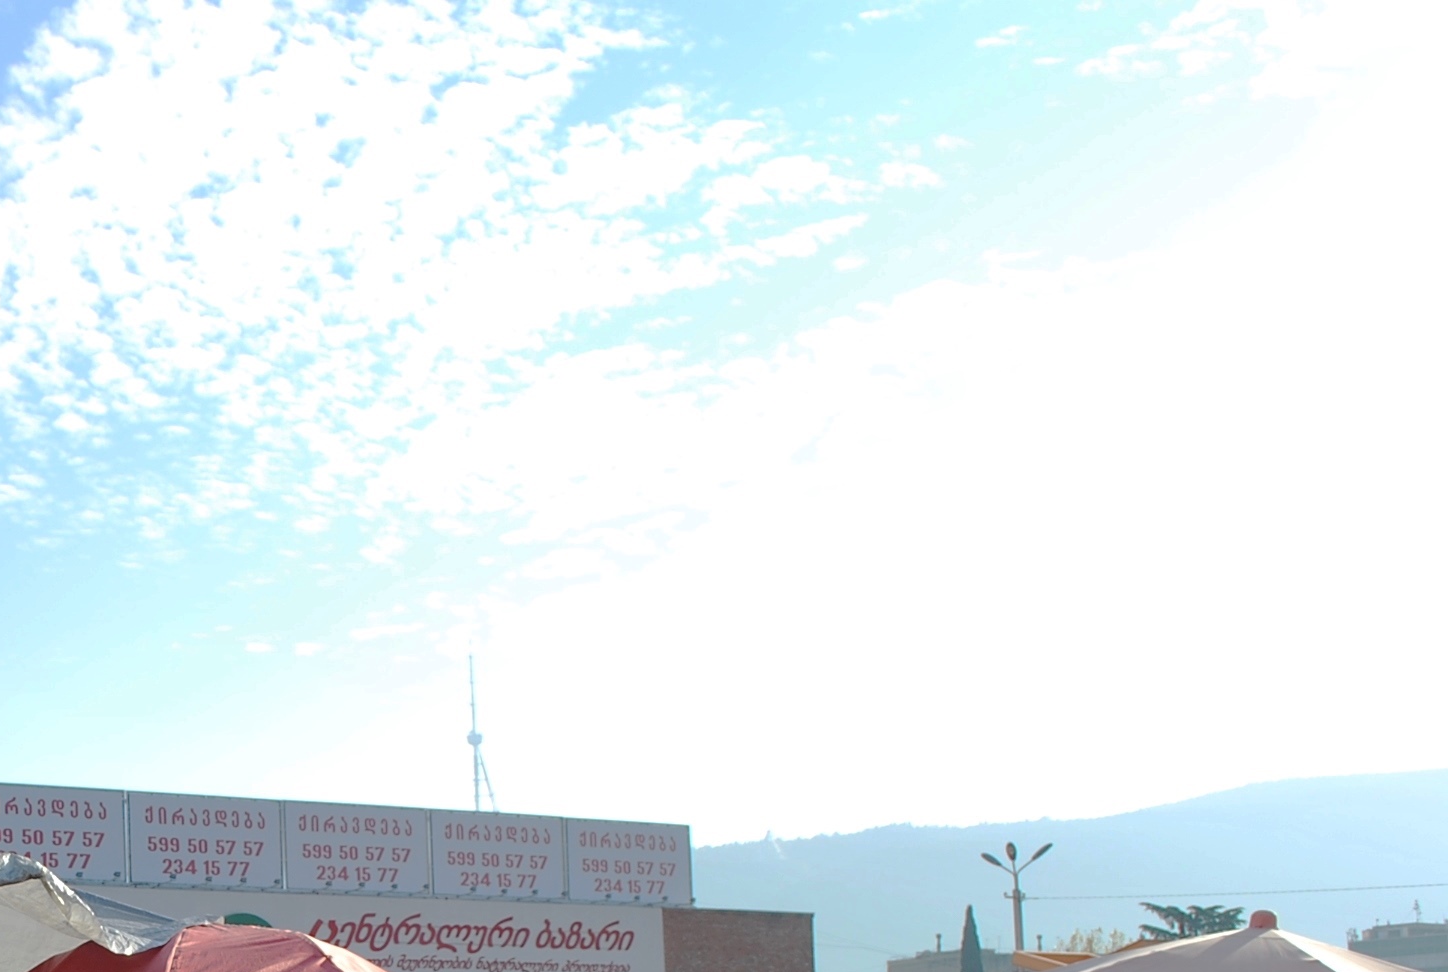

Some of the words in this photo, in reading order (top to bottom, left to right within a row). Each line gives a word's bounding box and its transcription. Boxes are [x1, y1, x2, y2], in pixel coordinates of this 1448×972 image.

[144, 805, 266, 830] ქირავდება
[298, 813, 413, 837] ქირავდება
[21, 829, 44, 845] 50
[52, 830, 75, 847] 57
[82, 831, 105, 848] 57
[444, 823, 551, 846] ქირავდება
[579, 831, 677, 853] ქირავდება
[147, 836, 180, 853] 599
[187, 839, 208, 855] 50
[216, 840, 237, 856] 57
[243, 841, 264, 857] 57
[302, 843, 332, 860] 599
[339, 845, 359, 861] 50
[365, 846, 385, 862] 57
[391, 847, 411, 863] 57
[41, 851, 60, 869] 15
[66, 853, 92, 870] 77
[162, 858, 198, 876] 234
[204, 859, 221, 876] 15
[227, 861, 250, 877] 77
[447, 851, 475, 867] 599
[481, 853, 500, 868] 50
[505, 854, 524, 869] 57
[529, 855, 548, 870] 57
[582, 858, 608, 873] 599
[614, 859, 631, 874] 50
[636, 861, 654, 876] 57
[659, 862, 676, 877] 57
[316, 865, 349, 881] 234
[355, 866, 371, 882] 15
[377, 868, 399, 883] 77
[460, 872, 490, 887] 234
[497, 873, 512, 888] 15
[517, 874, 537, 889] 77
[594, 878, 623, 894] 234
[628, 879, 642, 895] 15
[646, 881, 665, 895] 77
[535, 919, 635, 951] ბაზარი
